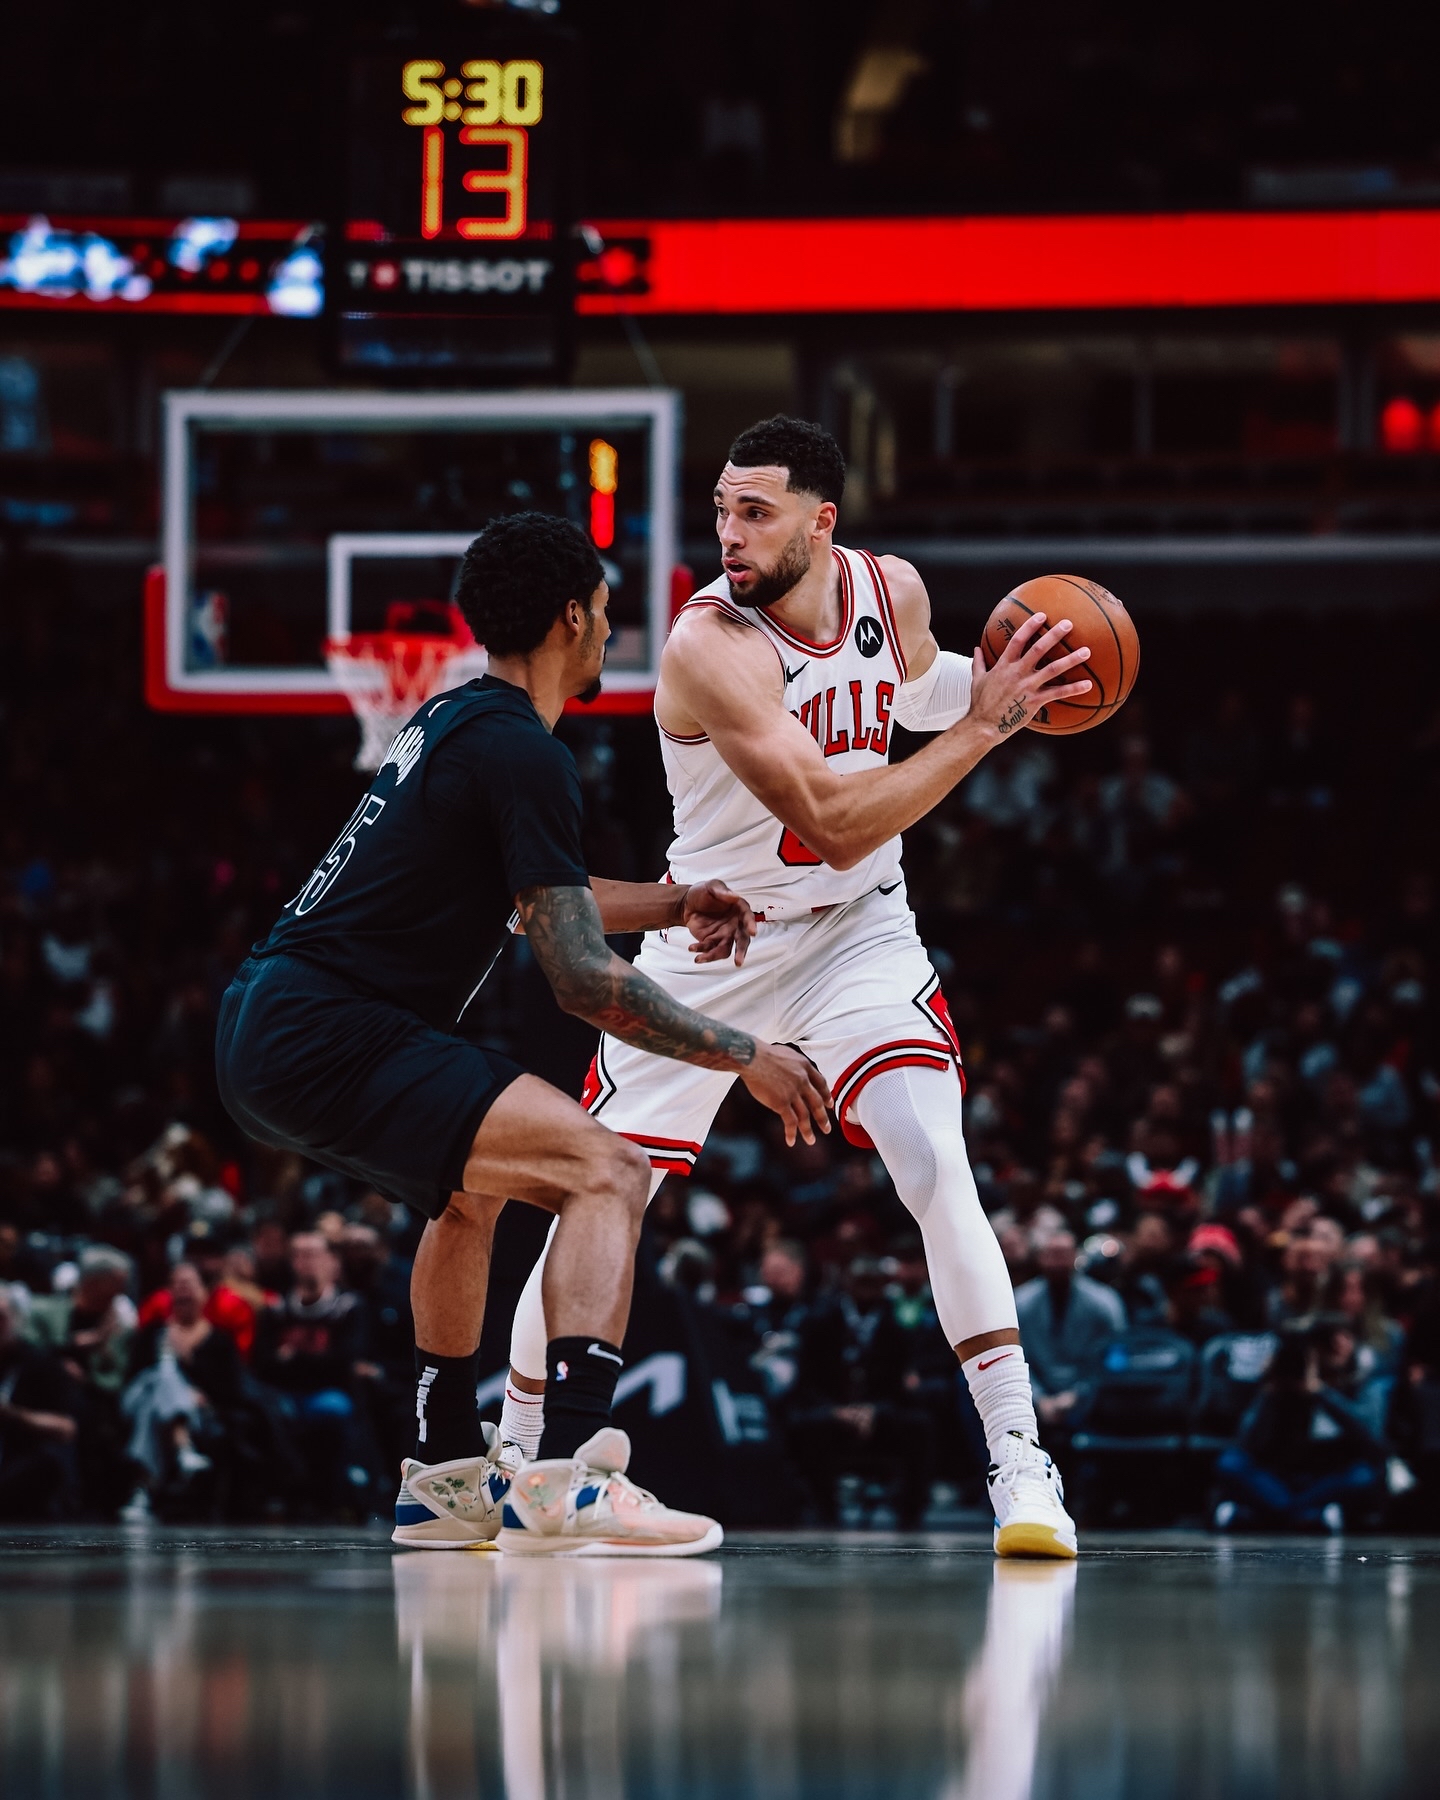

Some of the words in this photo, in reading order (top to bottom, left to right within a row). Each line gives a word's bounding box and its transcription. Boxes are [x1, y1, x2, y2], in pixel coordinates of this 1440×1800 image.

[402, 60, 543, 125] 5:30
[422, 125, 528, 239] 13
[404, 258, 550, 293] TISSOT
[789, 680, 895, 757] ULLS
[998, 695, 1028, 734] Saint
[283, 792, 387, 917] 5
